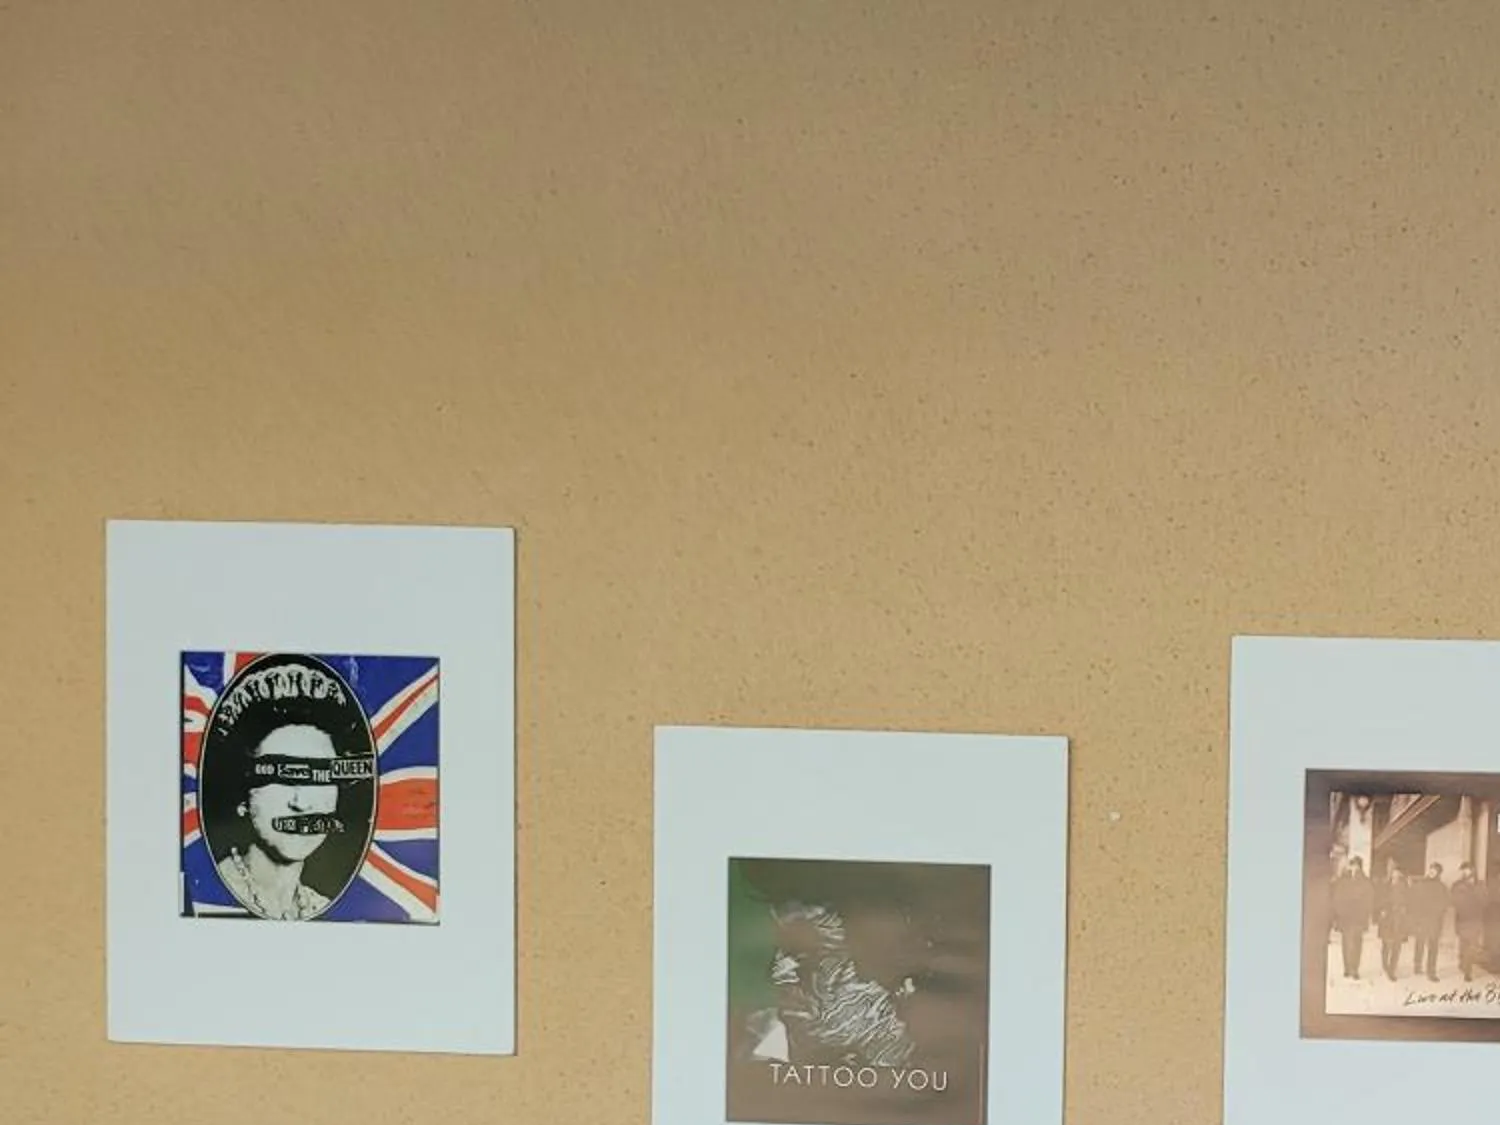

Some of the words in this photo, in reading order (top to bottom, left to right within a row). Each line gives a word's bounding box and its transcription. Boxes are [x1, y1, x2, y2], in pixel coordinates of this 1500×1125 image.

[312, 769, 332, 782] THE
[332, 760, 373, 777] QUEEN
[769, 1063, 878, 1088] TATTOO
[891, 1068, 948, 1091] YOU
